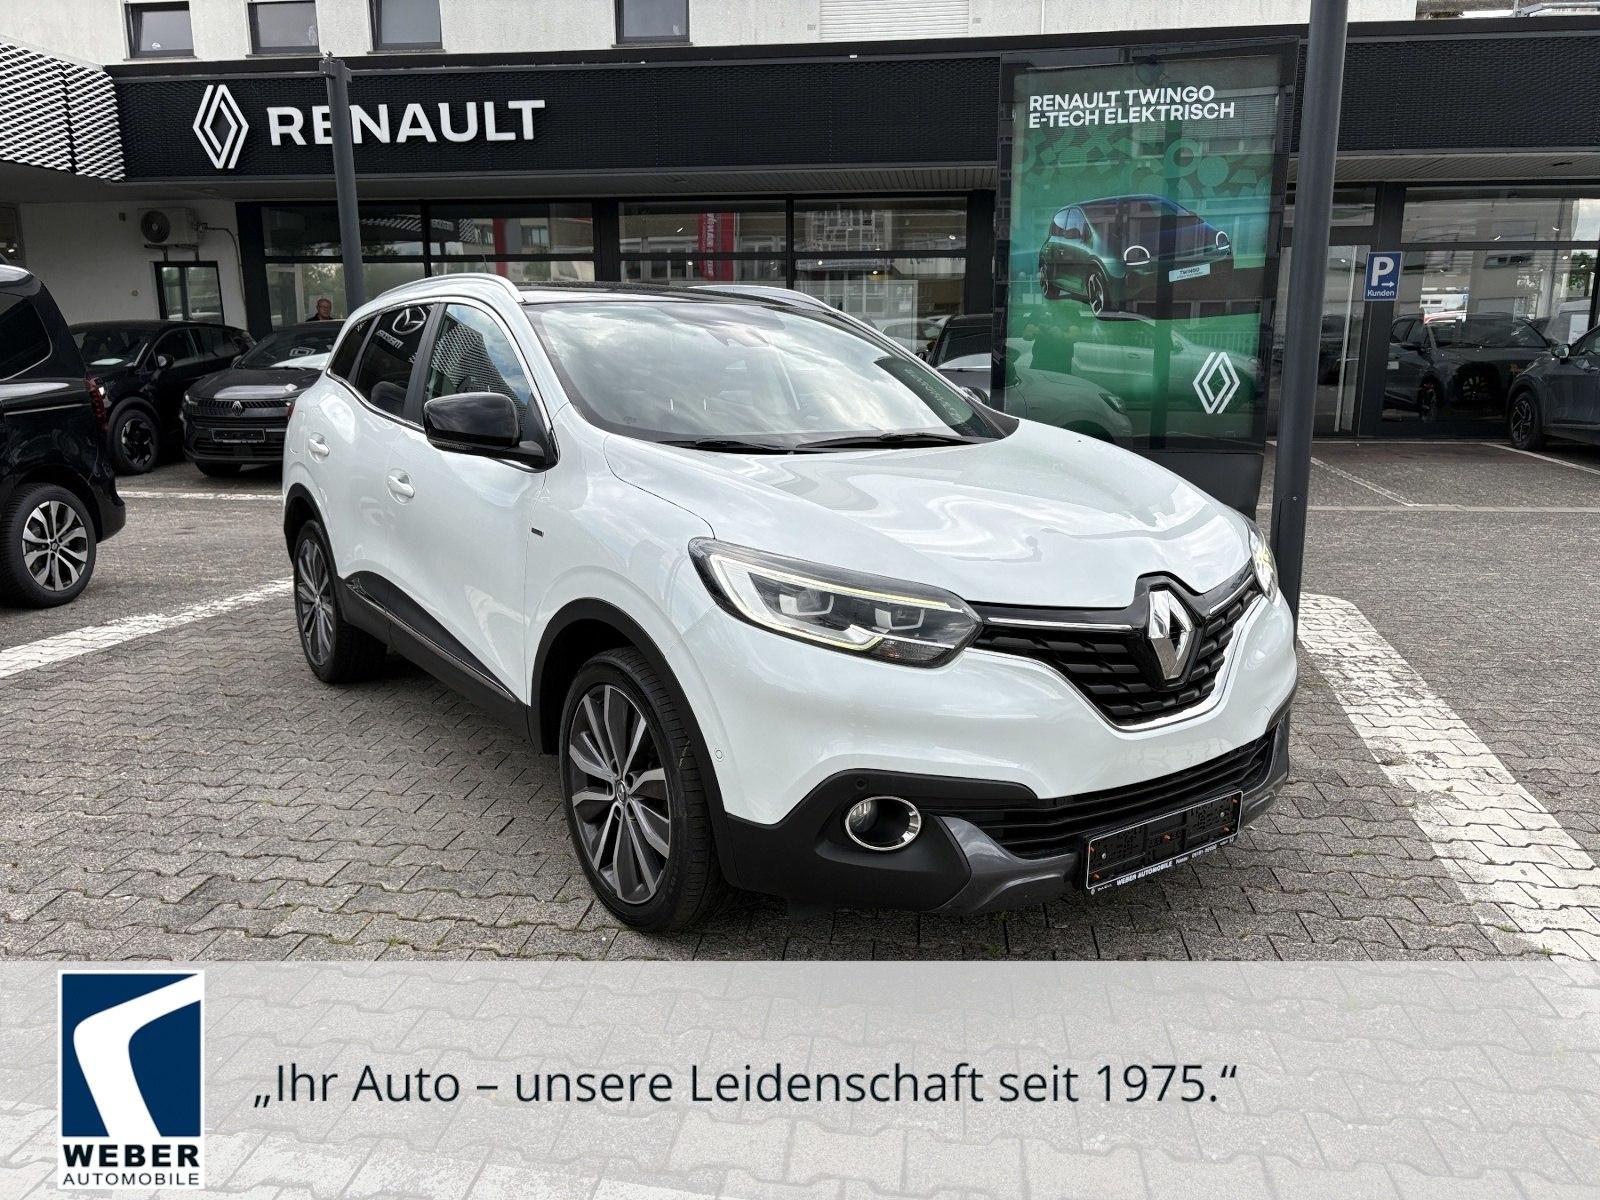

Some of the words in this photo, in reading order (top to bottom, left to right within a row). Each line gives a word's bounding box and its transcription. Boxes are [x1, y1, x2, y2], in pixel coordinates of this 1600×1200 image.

[1029, 91, 1121, 111] RENAULT
[1124, 85, 1215, 106] TWINGO
[266, 99, 546, 146] RENAULT
[1028, 109, 1100, 129] E-TECH
[1104, 102, 1235, 125] ELEKTRISCH
[1371, 256, 1395, 287] P
[1367, 289, 1395, 297] Kunden
[1137, 860, 1173, 879] AUTOMOBILE
